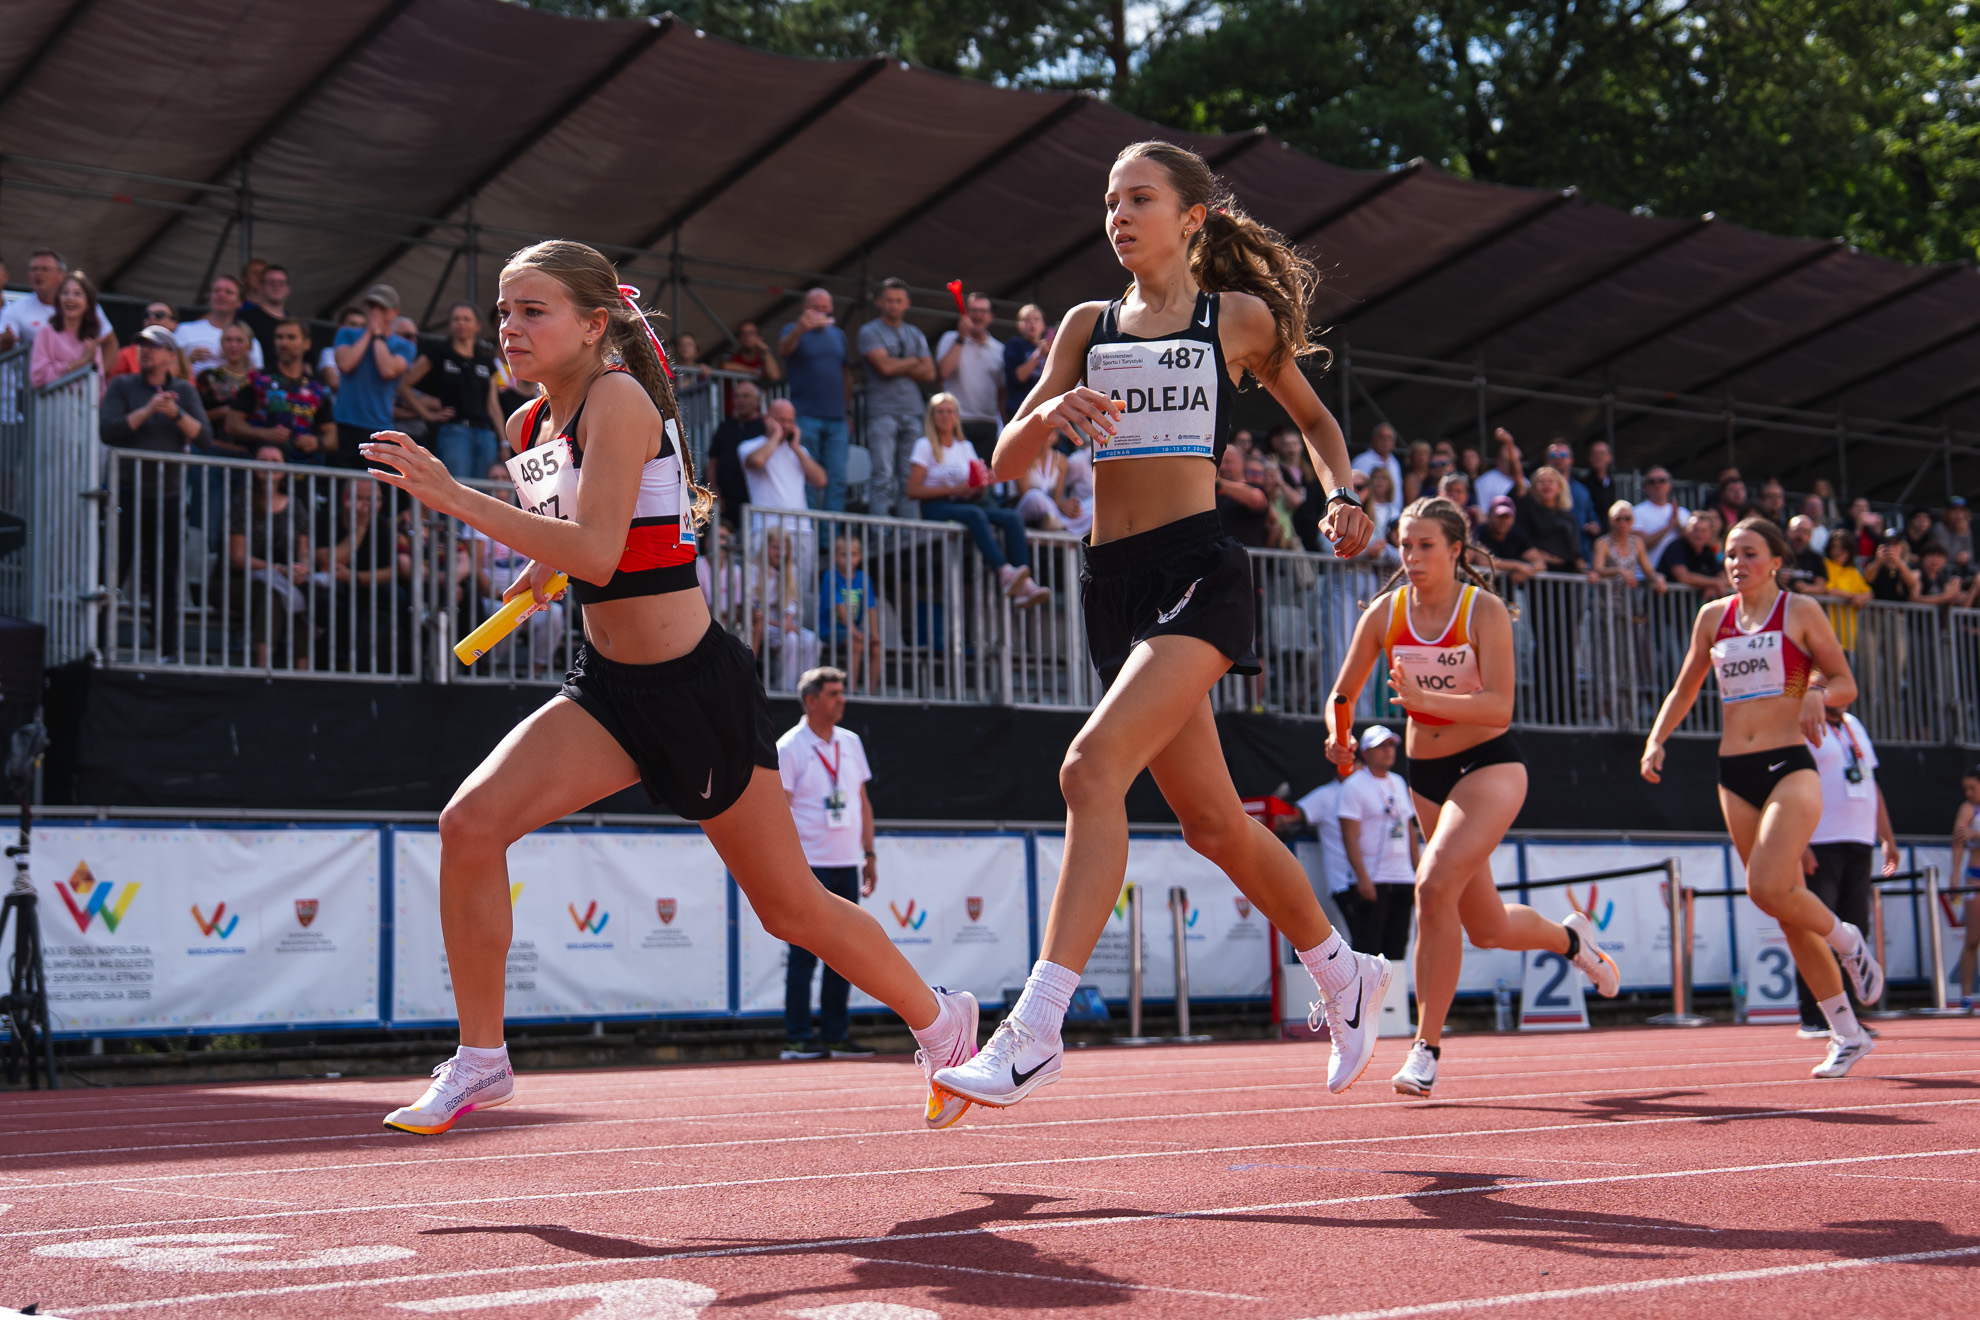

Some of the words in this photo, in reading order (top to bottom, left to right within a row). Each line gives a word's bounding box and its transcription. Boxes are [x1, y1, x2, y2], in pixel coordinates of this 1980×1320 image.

[1158, 347, 1205, 369] 487
[520, 450, 559, 485] 485
[1748, 636, 1774, 649] 471
[1437, 650, 1466, 666] 467
[1722, 657, 1770, 678] SZOPA
[1416, 675, 1457, 690] HOC
[1533, 950, 1571, 1007] 2
[1757, 946, 1792, 1000] 3
[445, 1091, 466, 1112] new
[465, 1069, 507, 1098] balance
